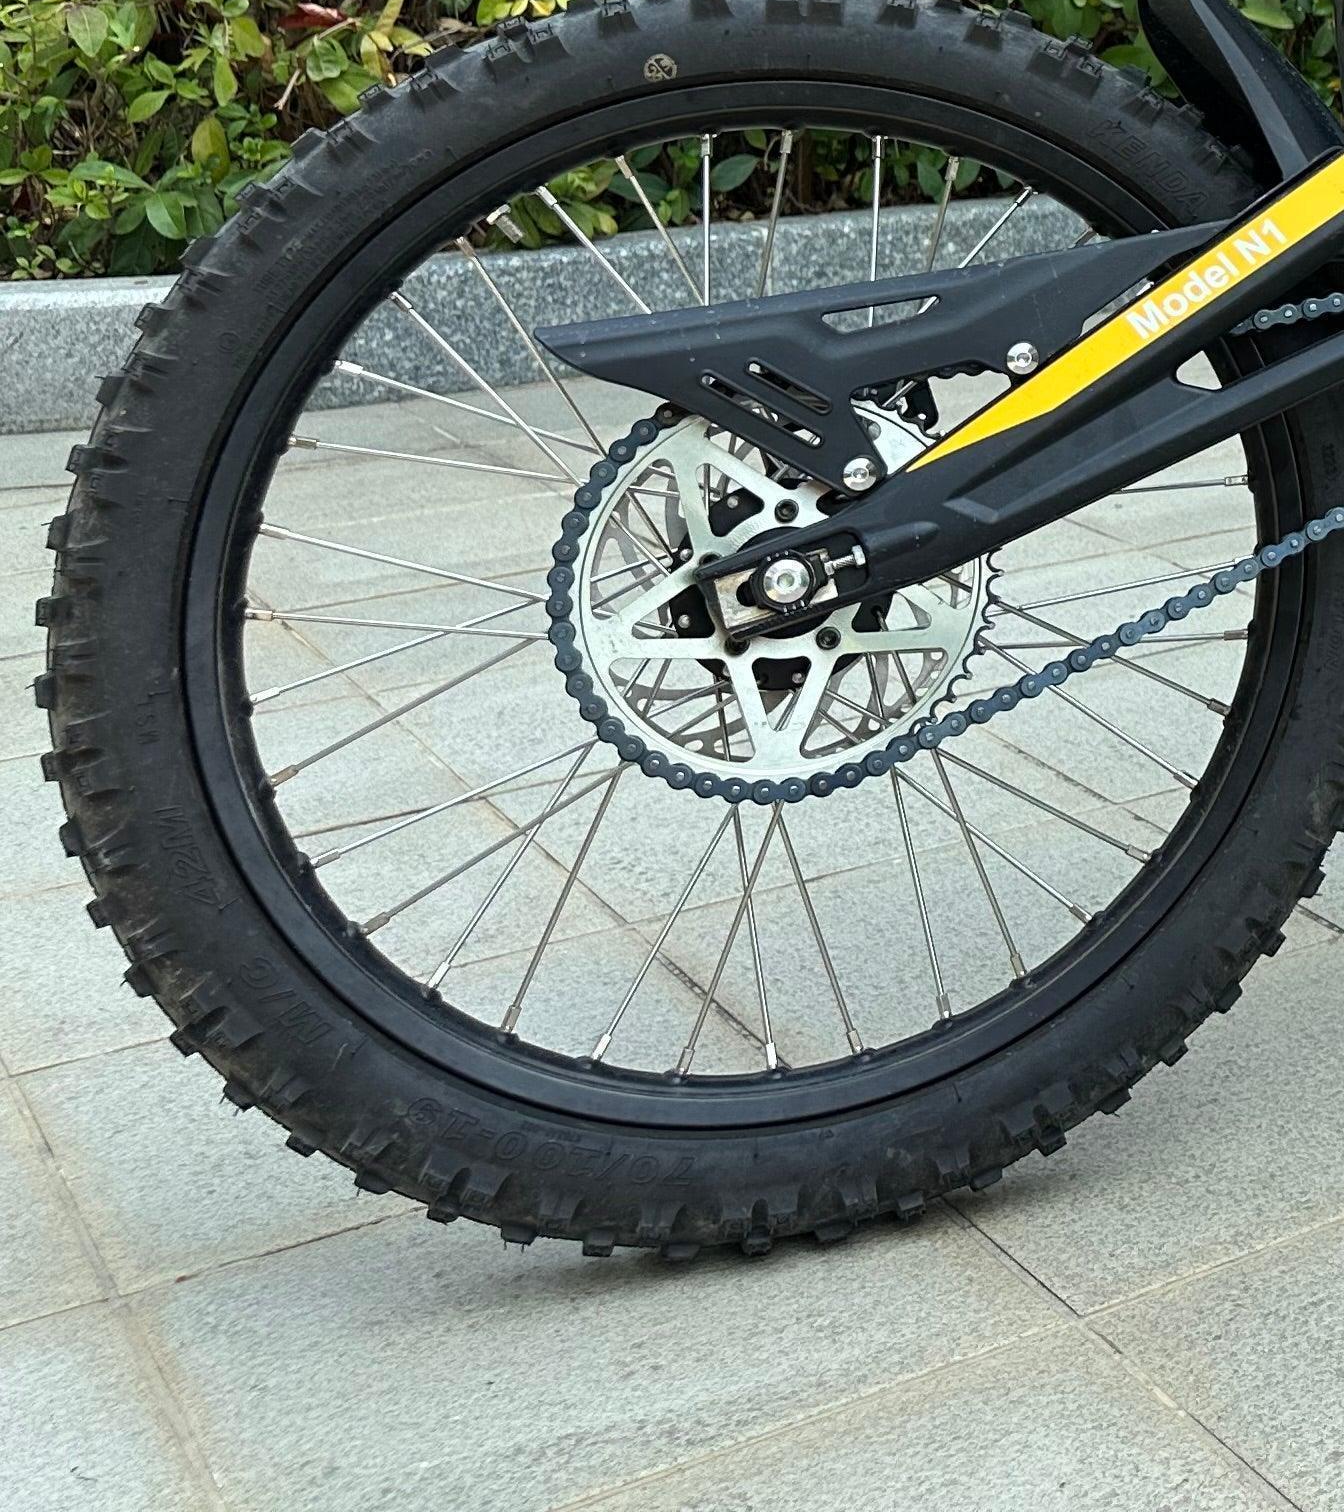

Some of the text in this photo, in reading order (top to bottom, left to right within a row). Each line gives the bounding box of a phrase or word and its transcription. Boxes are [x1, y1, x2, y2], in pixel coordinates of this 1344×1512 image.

[1086, 118, 1210, 220] KENDA
[1126, 217, 1288, 340] Model N1
